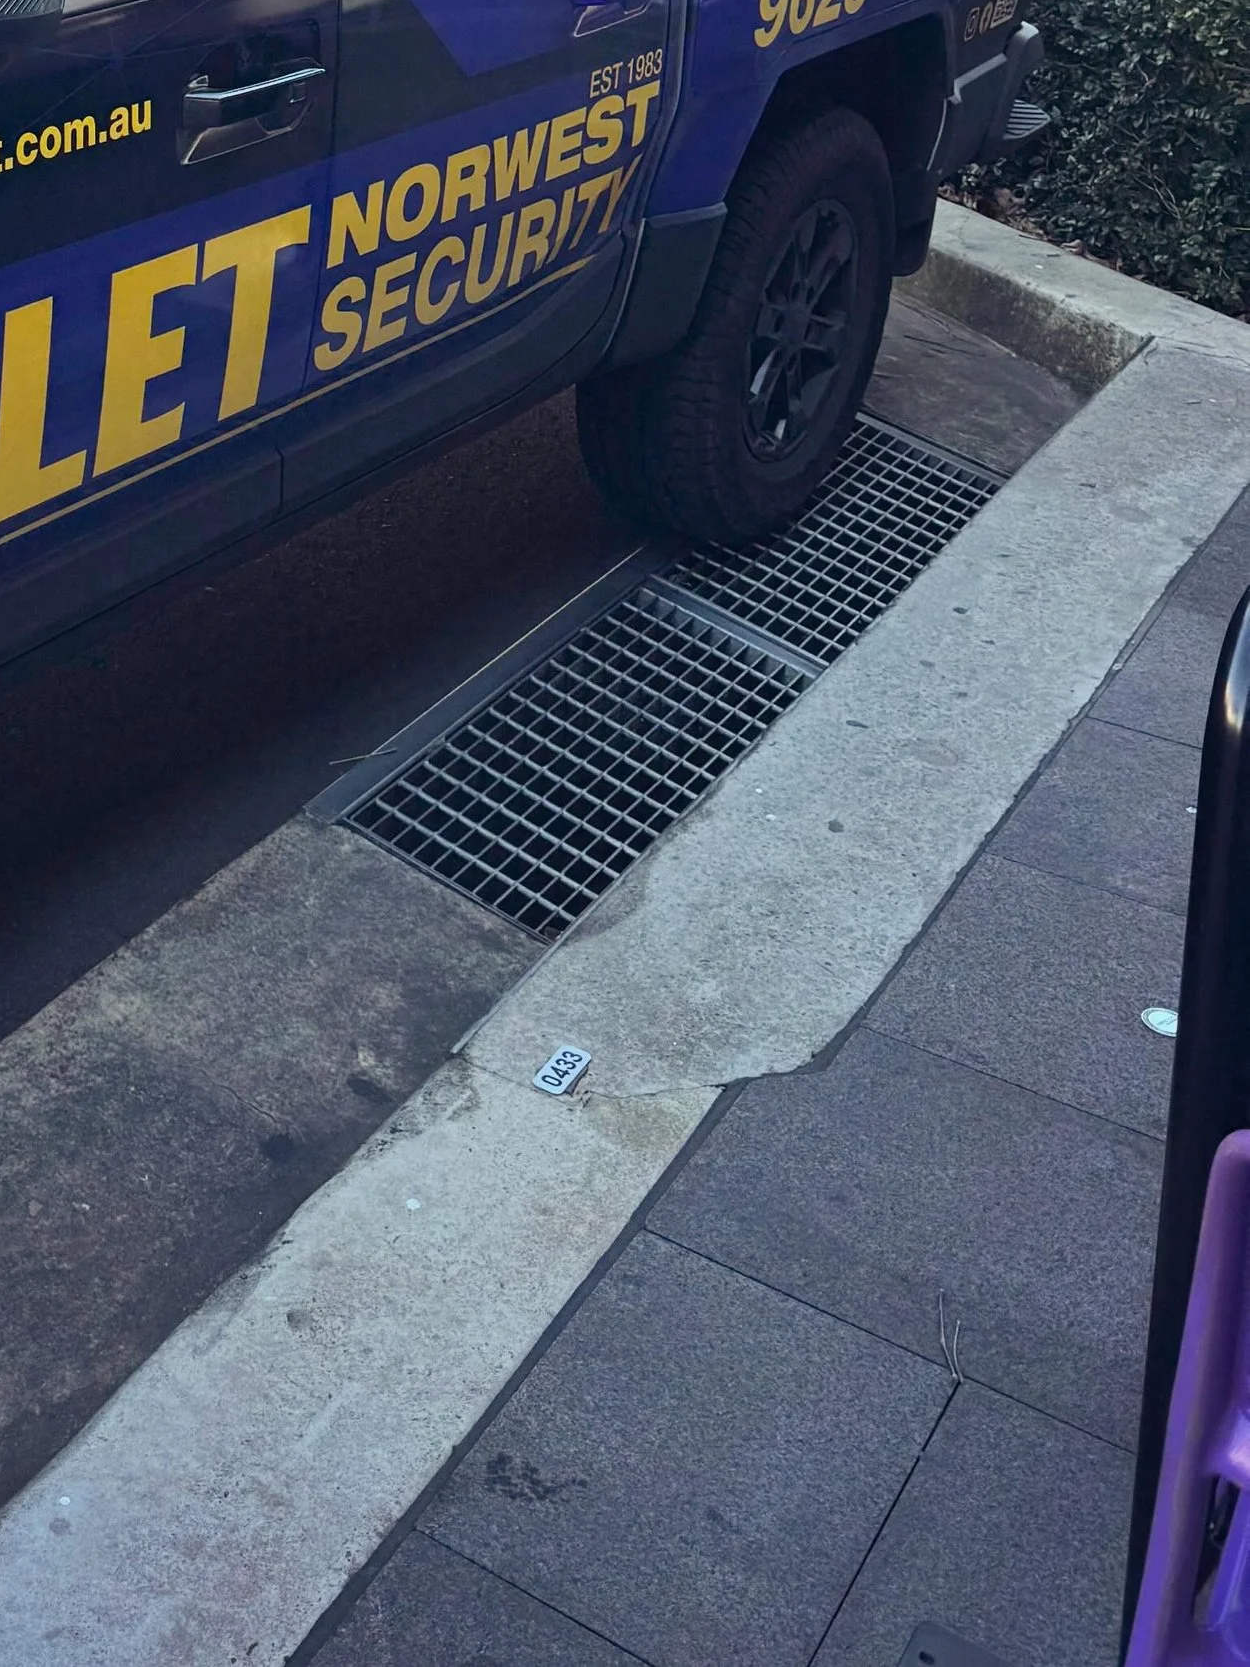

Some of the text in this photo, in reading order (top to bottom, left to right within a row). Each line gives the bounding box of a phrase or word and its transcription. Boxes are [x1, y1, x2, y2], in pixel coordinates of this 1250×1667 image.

[589, 48, 664, 99] EST 1983
[326, 80, 661, 270] NORWEST
[313, 153, 643, 373] SECURITY
[541, 1050, 583, 1087] 0433
